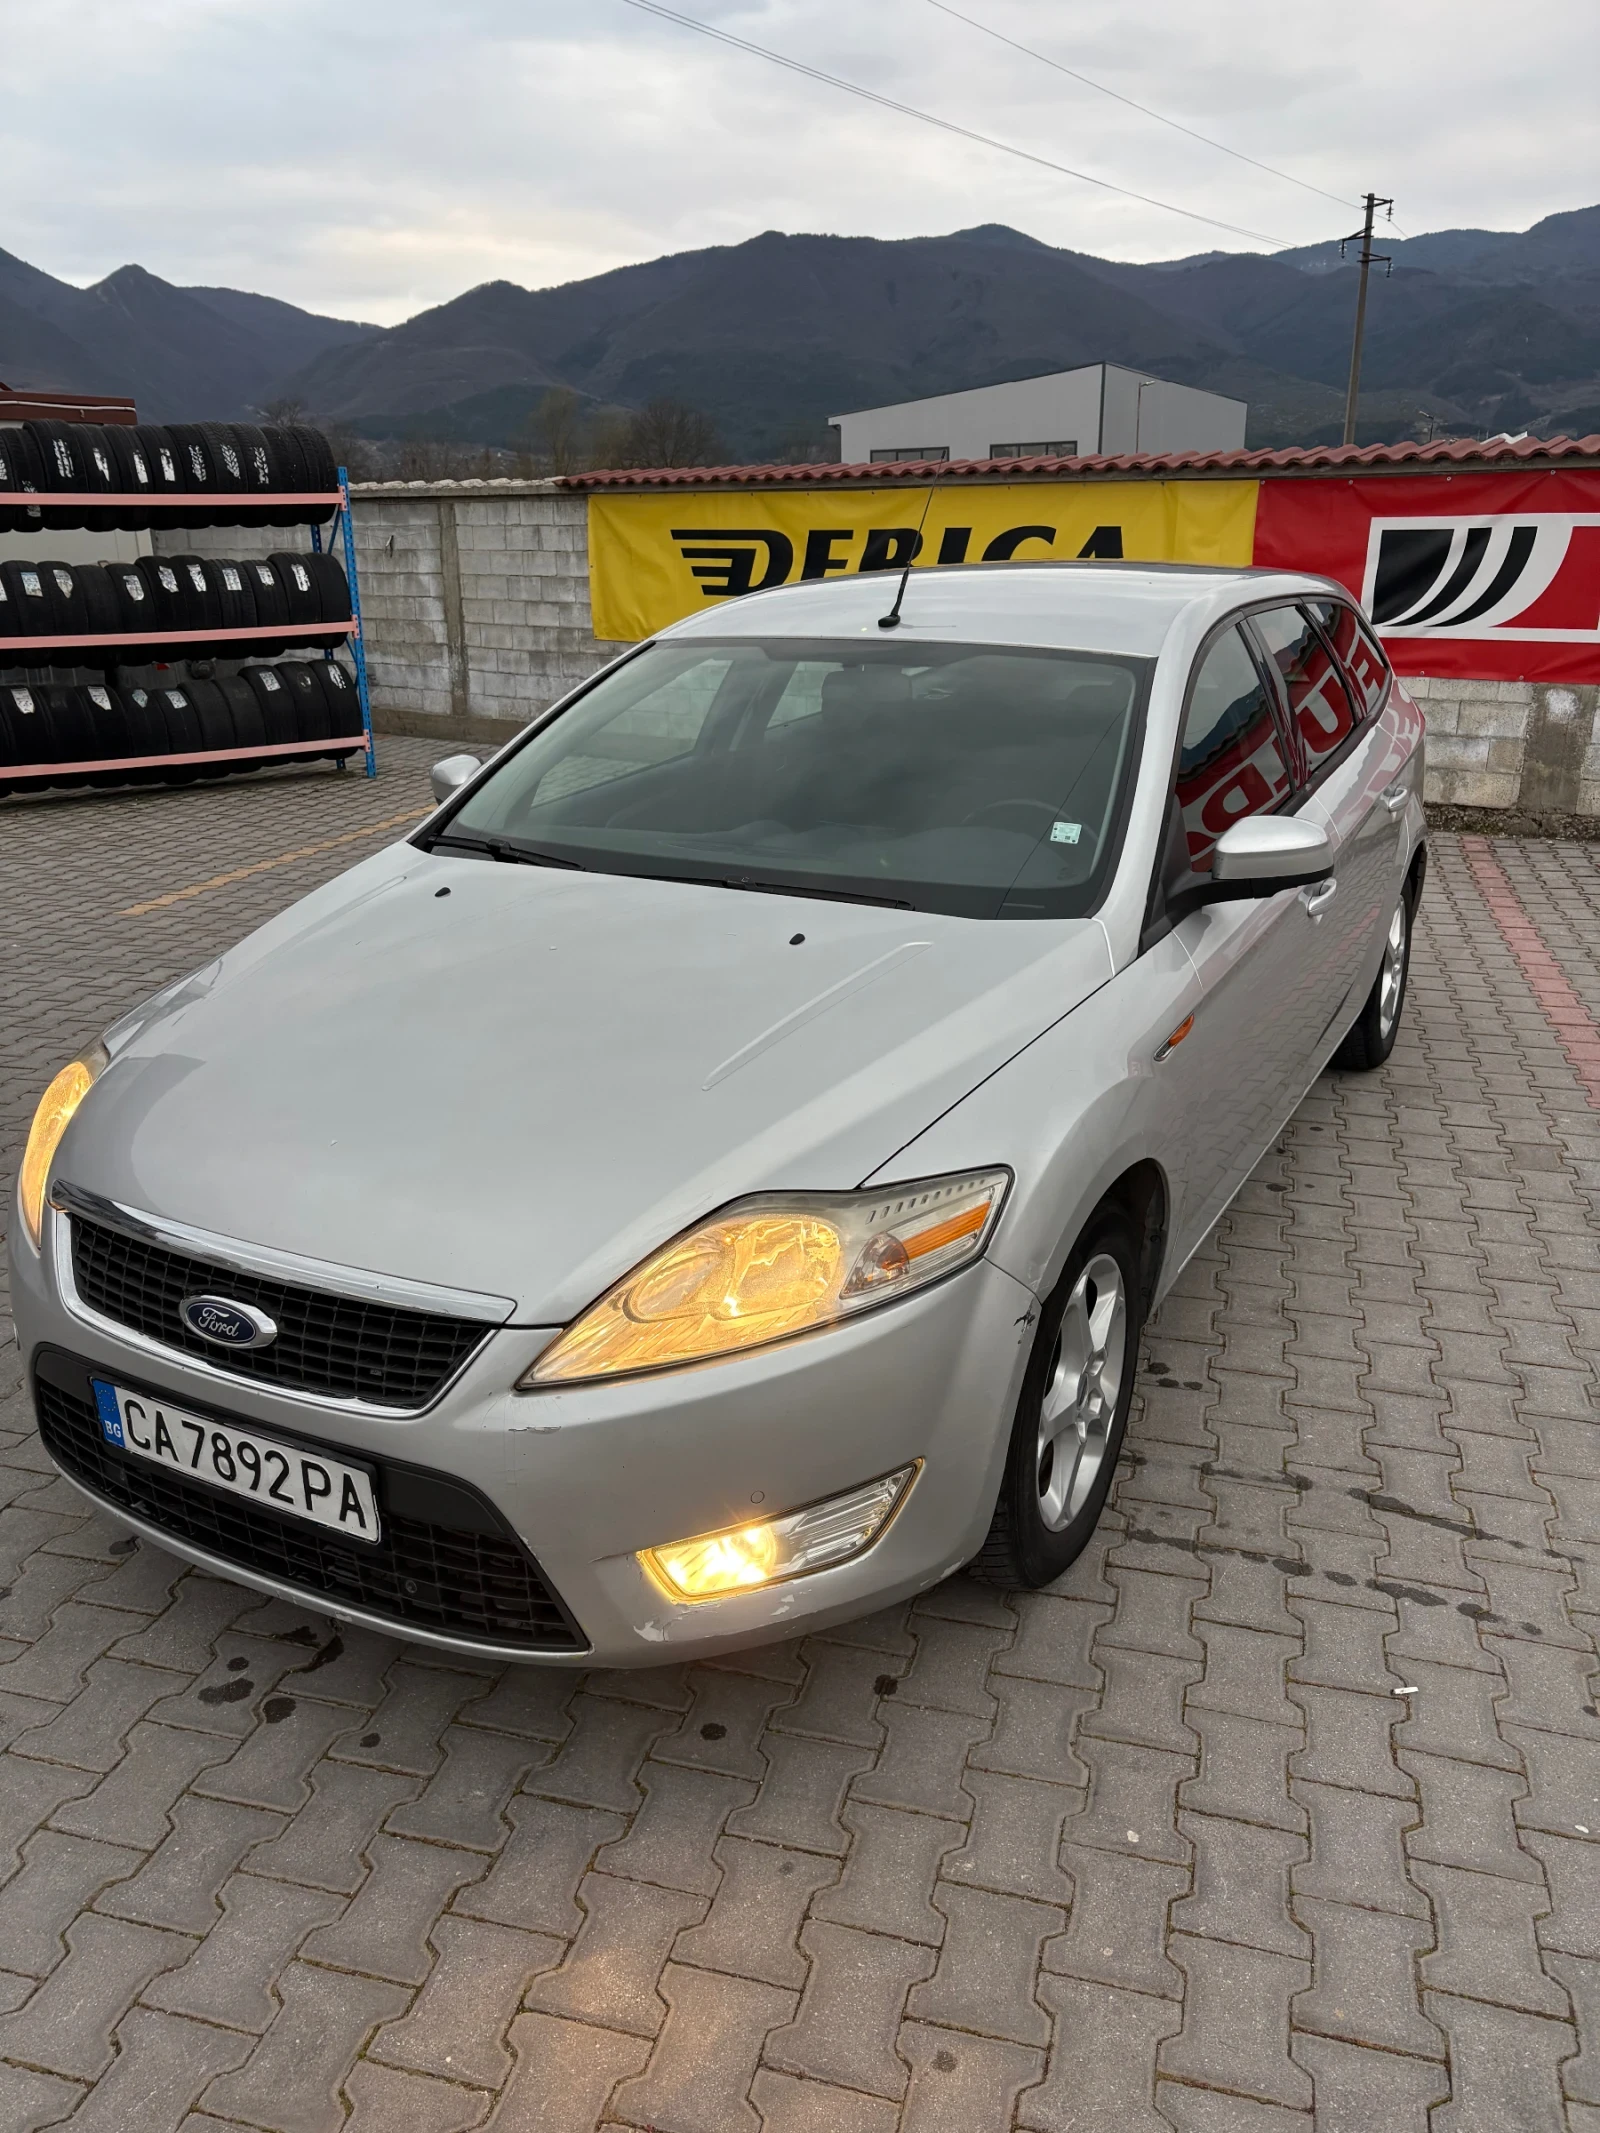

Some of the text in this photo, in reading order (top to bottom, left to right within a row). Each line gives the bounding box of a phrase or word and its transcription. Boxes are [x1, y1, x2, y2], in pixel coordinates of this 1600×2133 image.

[198, 1307, 240, 1337] Ford
[104, 1420, 122, 1439] BG
[124, 1398, 367, 1529] CA7892PA
